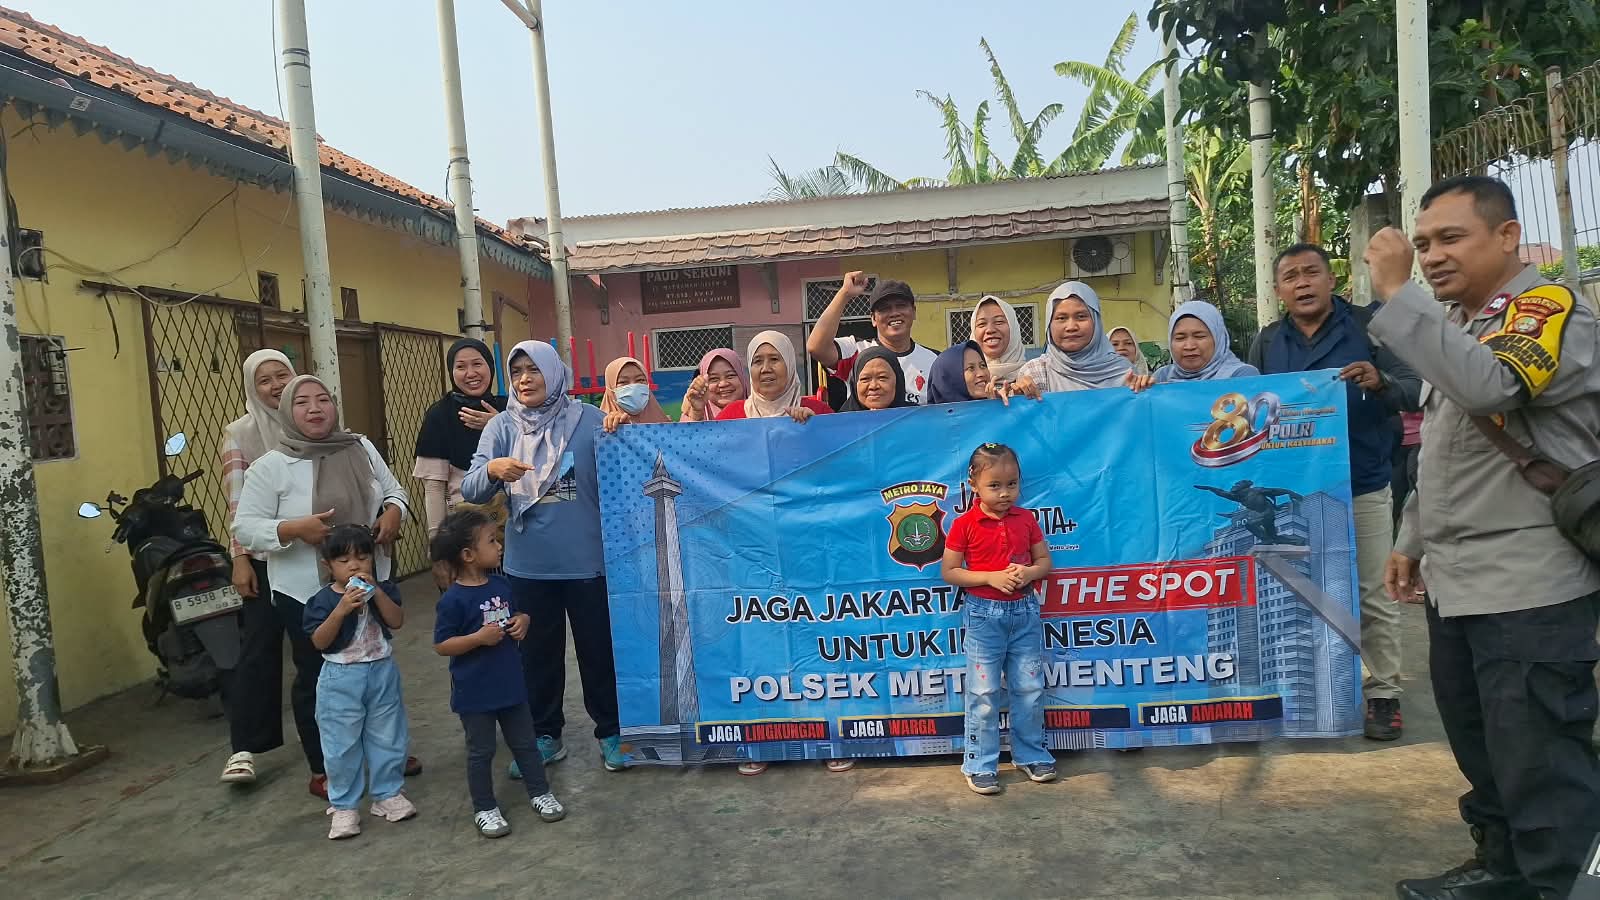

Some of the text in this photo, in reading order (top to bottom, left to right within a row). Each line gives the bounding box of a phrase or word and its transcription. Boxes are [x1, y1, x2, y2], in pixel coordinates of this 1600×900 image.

[1202, 392, 1280, 450] 80
[1268, 422, 1315, 440] POLRI
[884, 484, 943, 501] METRO JAYA
[175, 600, 182, 610] B
[187, 592, 216, 607] 5938
[727, 596, 814, 623] JAGA
[1057, 575, 1129, 605] THE
[1136, 568, 1235, 600] SPOT
[818, 629, 942, 661] UNTUK
[730, 671, 879, 702] POLSEK
[1043, 653, 1234, 687] MENTENG
[1045, 710, 1091, 728] TURAN
[1150, 702, 1254, 724] JAGA AMANAH
[708, 722, 825, 743] JAGA LINGKUNGAN
[850, 719, 936, 738] JAGA WARGA
